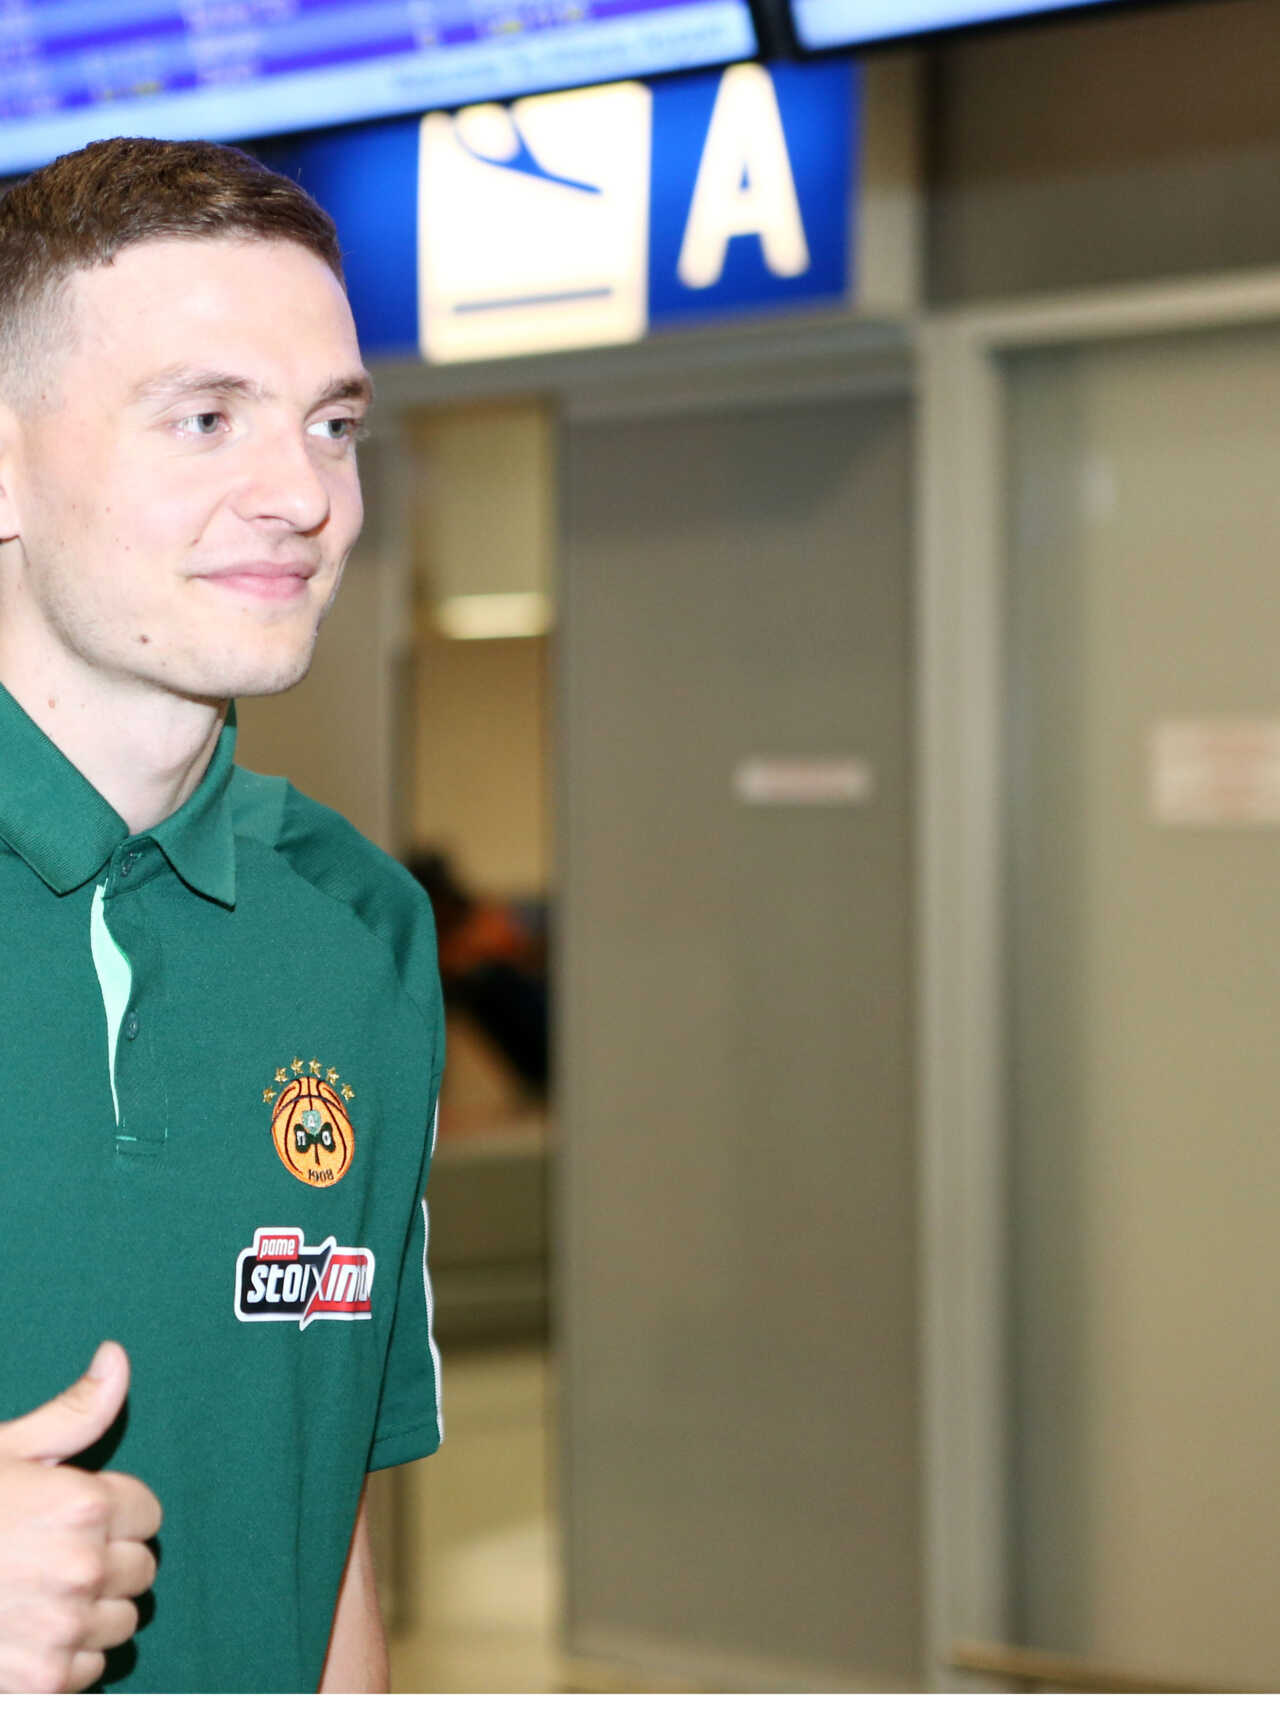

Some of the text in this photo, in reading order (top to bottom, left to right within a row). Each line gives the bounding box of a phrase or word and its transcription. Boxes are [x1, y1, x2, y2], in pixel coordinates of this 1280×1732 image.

[677, 61, 811, 290] A
[308, 1168, 334, 1182] 1908
[259, 1238, 295, 1259] pame
